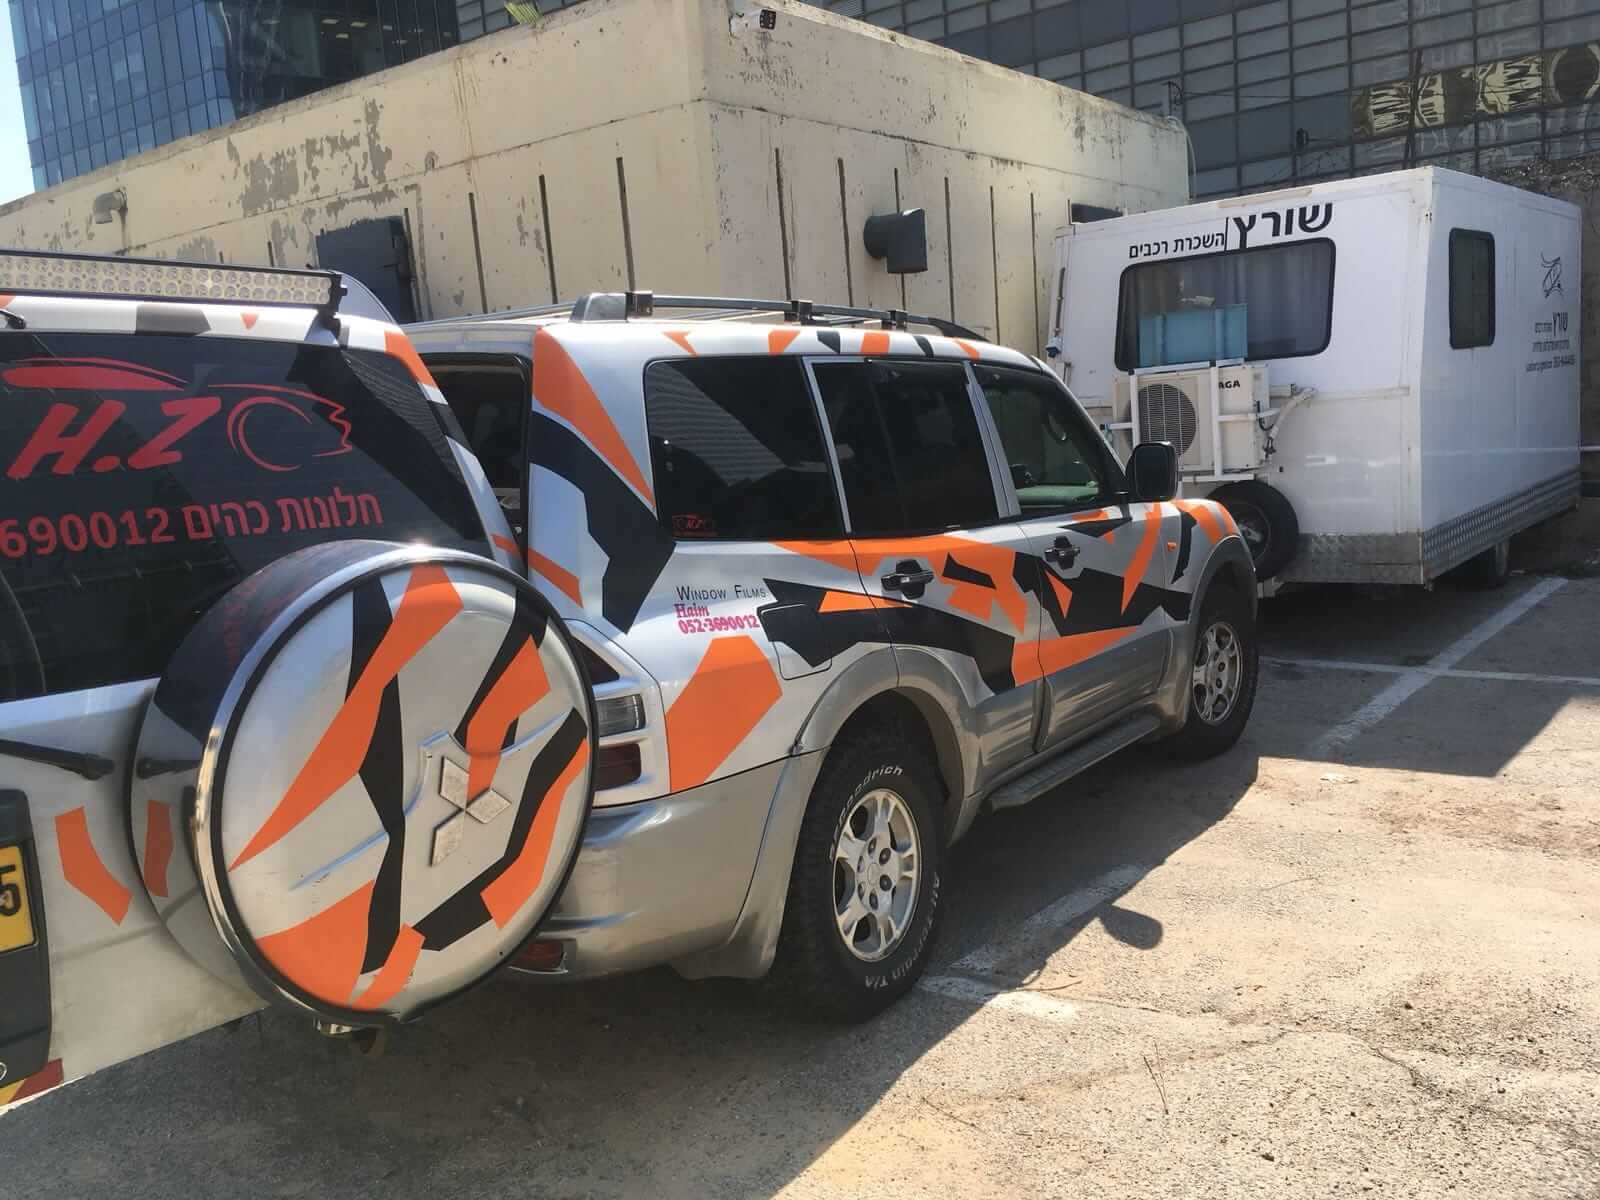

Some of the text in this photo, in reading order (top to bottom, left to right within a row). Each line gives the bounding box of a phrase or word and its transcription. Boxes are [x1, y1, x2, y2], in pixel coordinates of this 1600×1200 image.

[1129, 203, 1333, 258] שורץ השכרת רכבים
[182, 498, 270, 541] כהים
[276, 486, 383, 533] חלונות
[674, 603, 709, 618] Haim
